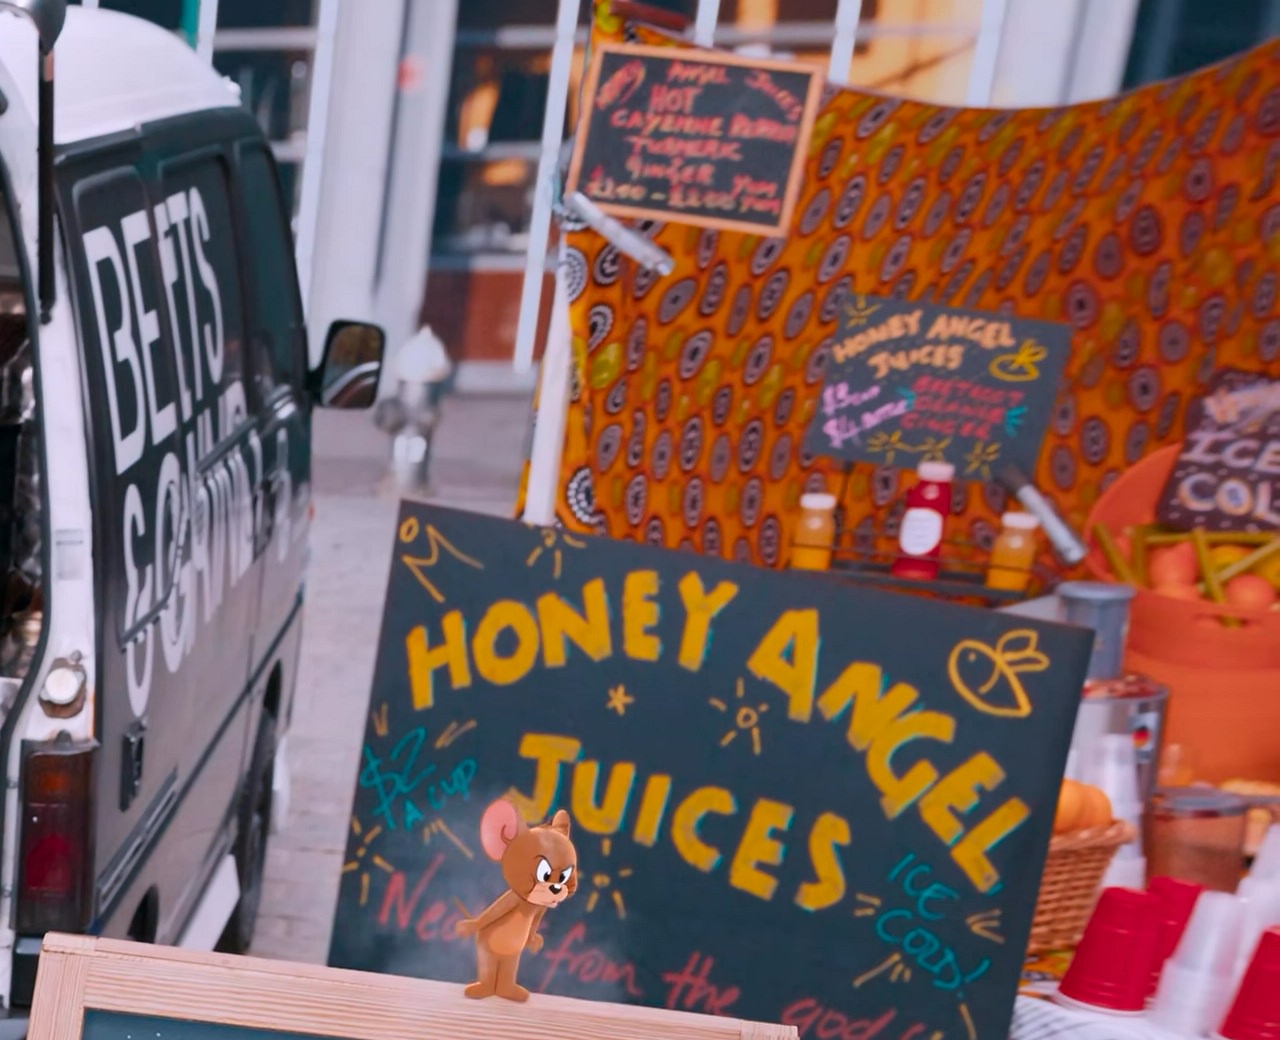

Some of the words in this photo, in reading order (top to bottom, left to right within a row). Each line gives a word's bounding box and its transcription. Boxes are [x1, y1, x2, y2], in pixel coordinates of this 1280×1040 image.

[406, 570, 739, 711] HONEY
[747, 607, 1031, 894] ANGEL
[508, 732, 852, 911] JUICES
[540, 921, 645, 991] from
[664, 952, 742, 1019] the
